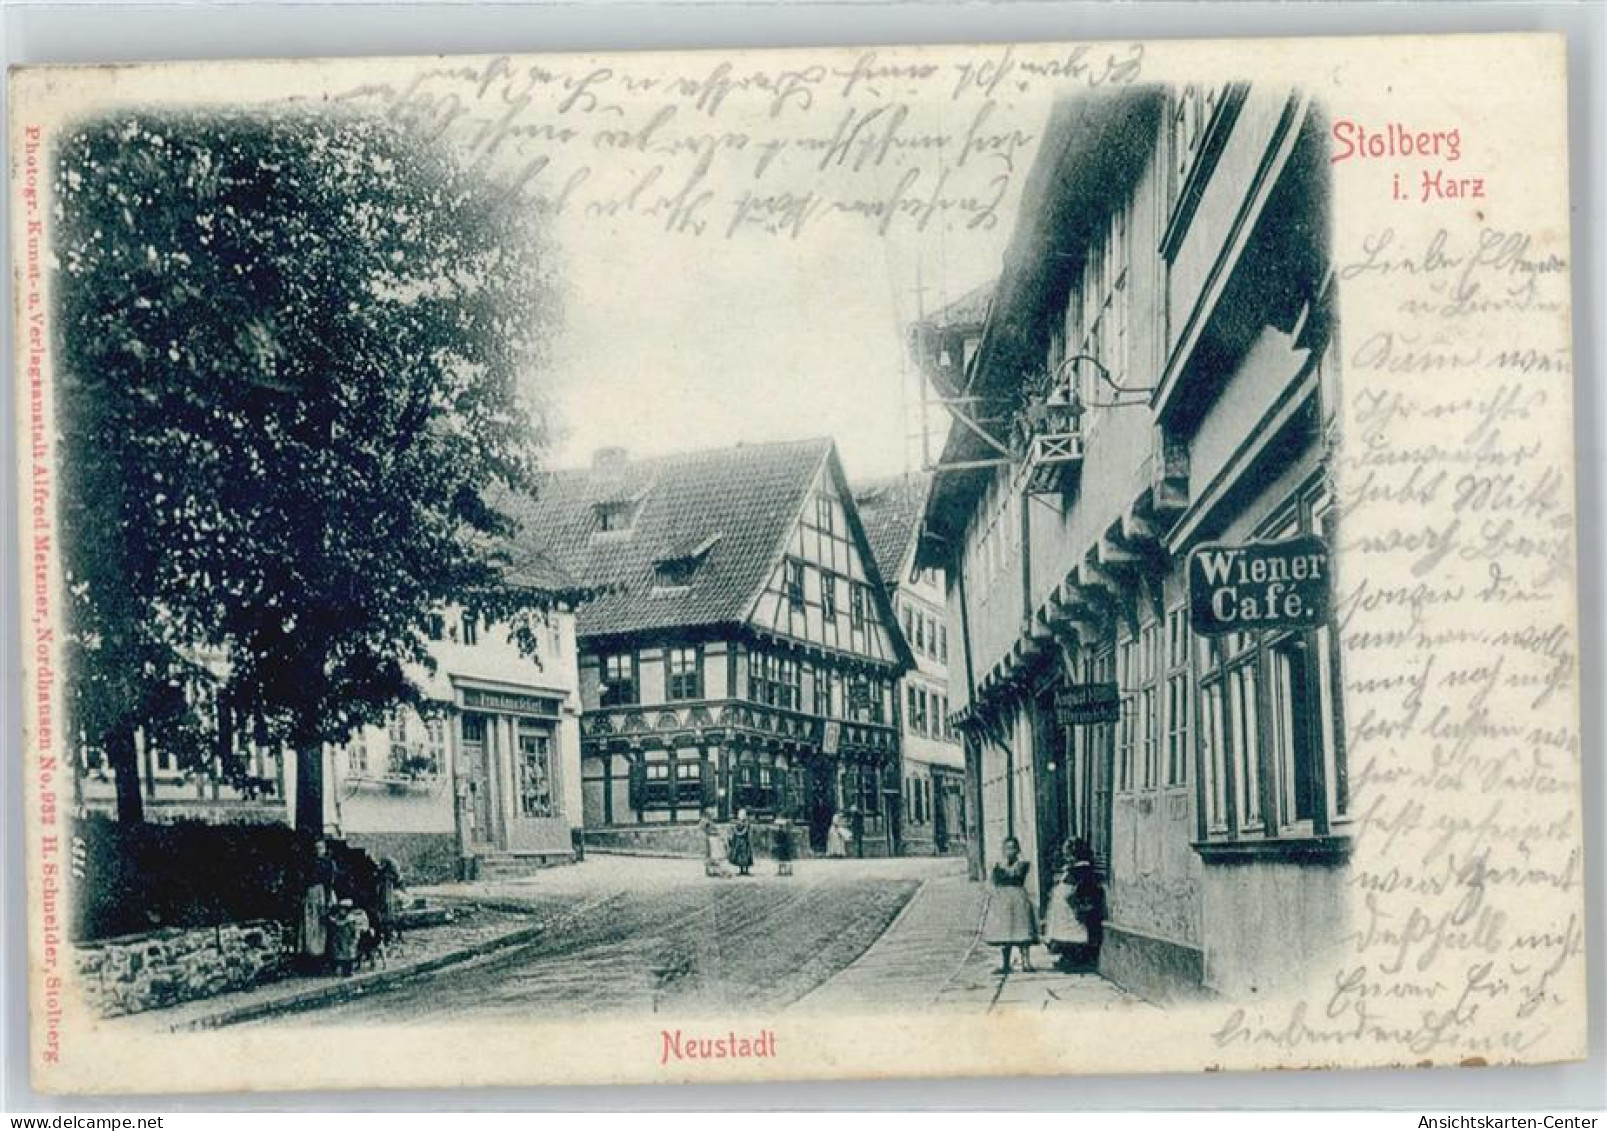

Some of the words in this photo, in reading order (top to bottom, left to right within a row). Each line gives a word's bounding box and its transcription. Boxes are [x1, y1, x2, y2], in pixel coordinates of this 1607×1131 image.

[1332, 119, 1462, 163] Stolberg
[23, 125, 41, 212] Photogr.
[1393, 173, 1409, 200] i.
[1421, 170, 1486, 203] Harz
[25, 217, 42, 283] Kunst-
[32, 463, 48, 529] Alfred
[1197, 549, 1326, 586] Wiener
[1212, 582, 1314, 622] Café.
[661, 1029, 776, 1065] Neustadt
